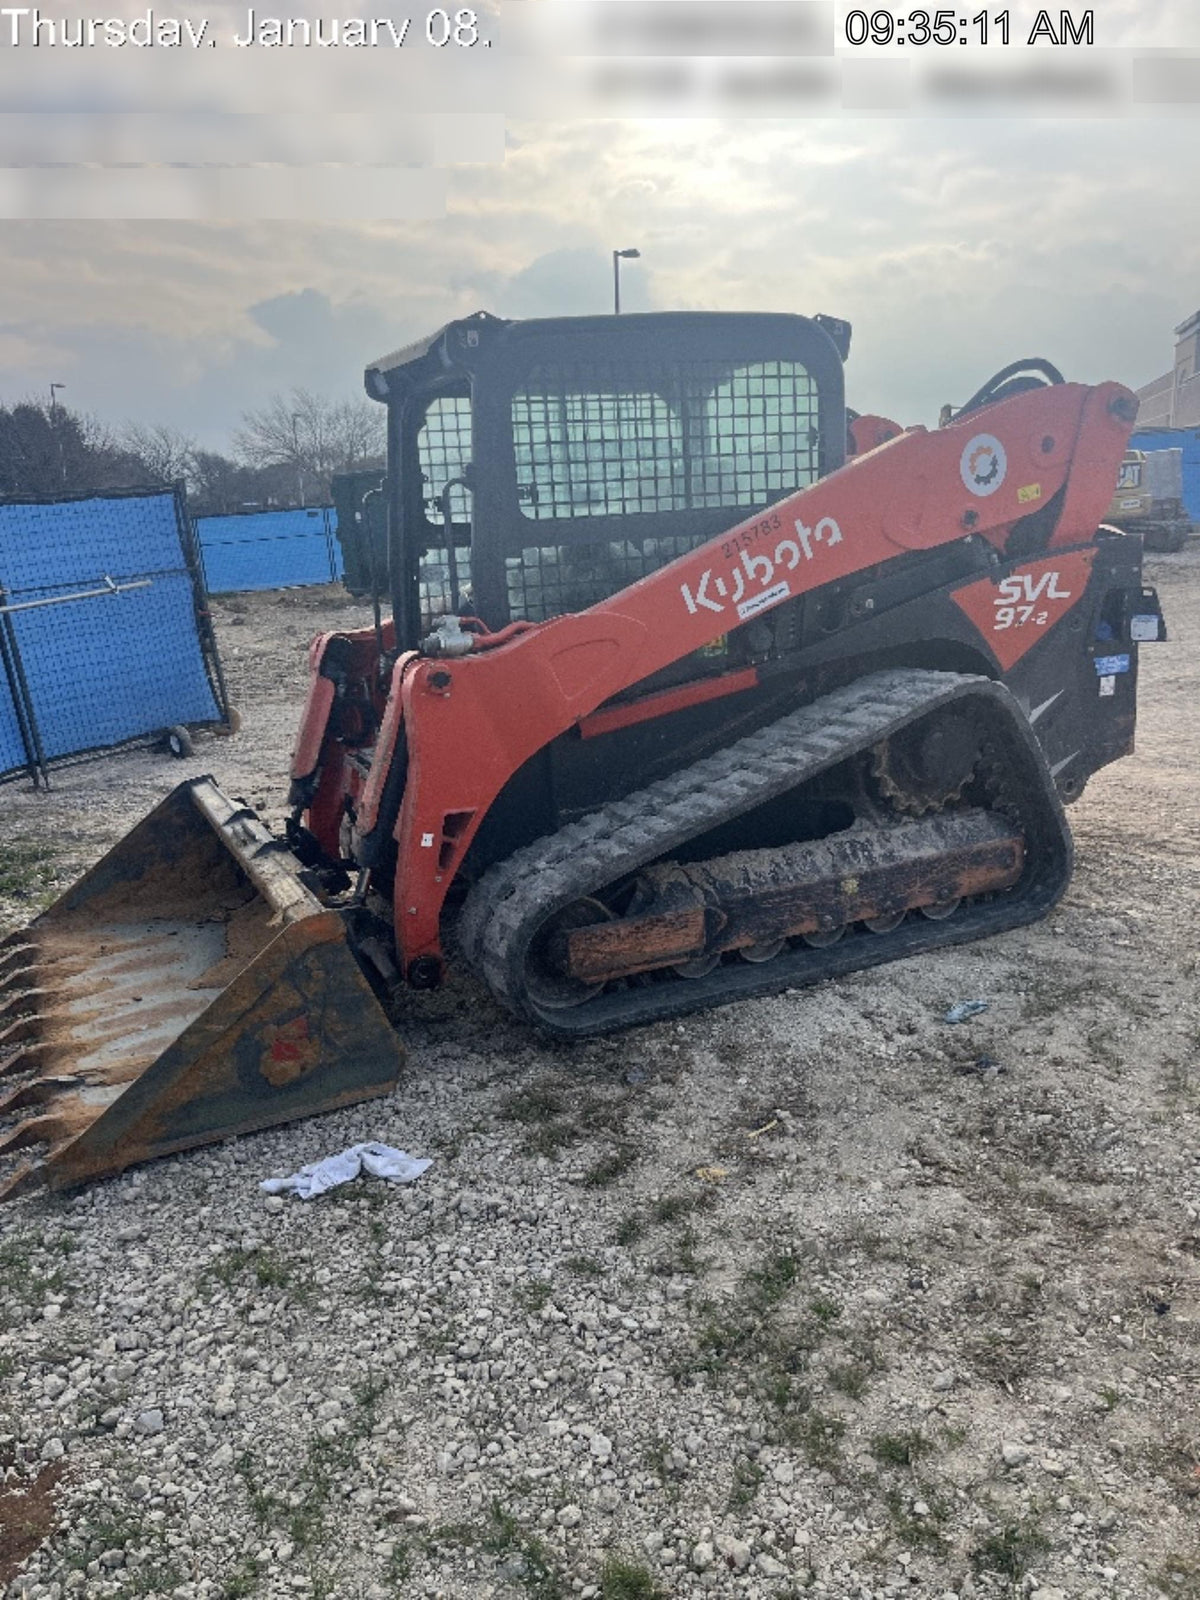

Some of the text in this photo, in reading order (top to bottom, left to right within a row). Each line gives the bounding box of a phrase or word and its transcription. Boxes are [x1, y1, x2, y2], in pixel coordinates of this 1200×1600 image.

[721, 513, 782, 558] 215783
[680, 517, 843, 614] Kubota
[993, 571, 1071, 605] SVL
[993, 604, 1048, 631] 97-2
